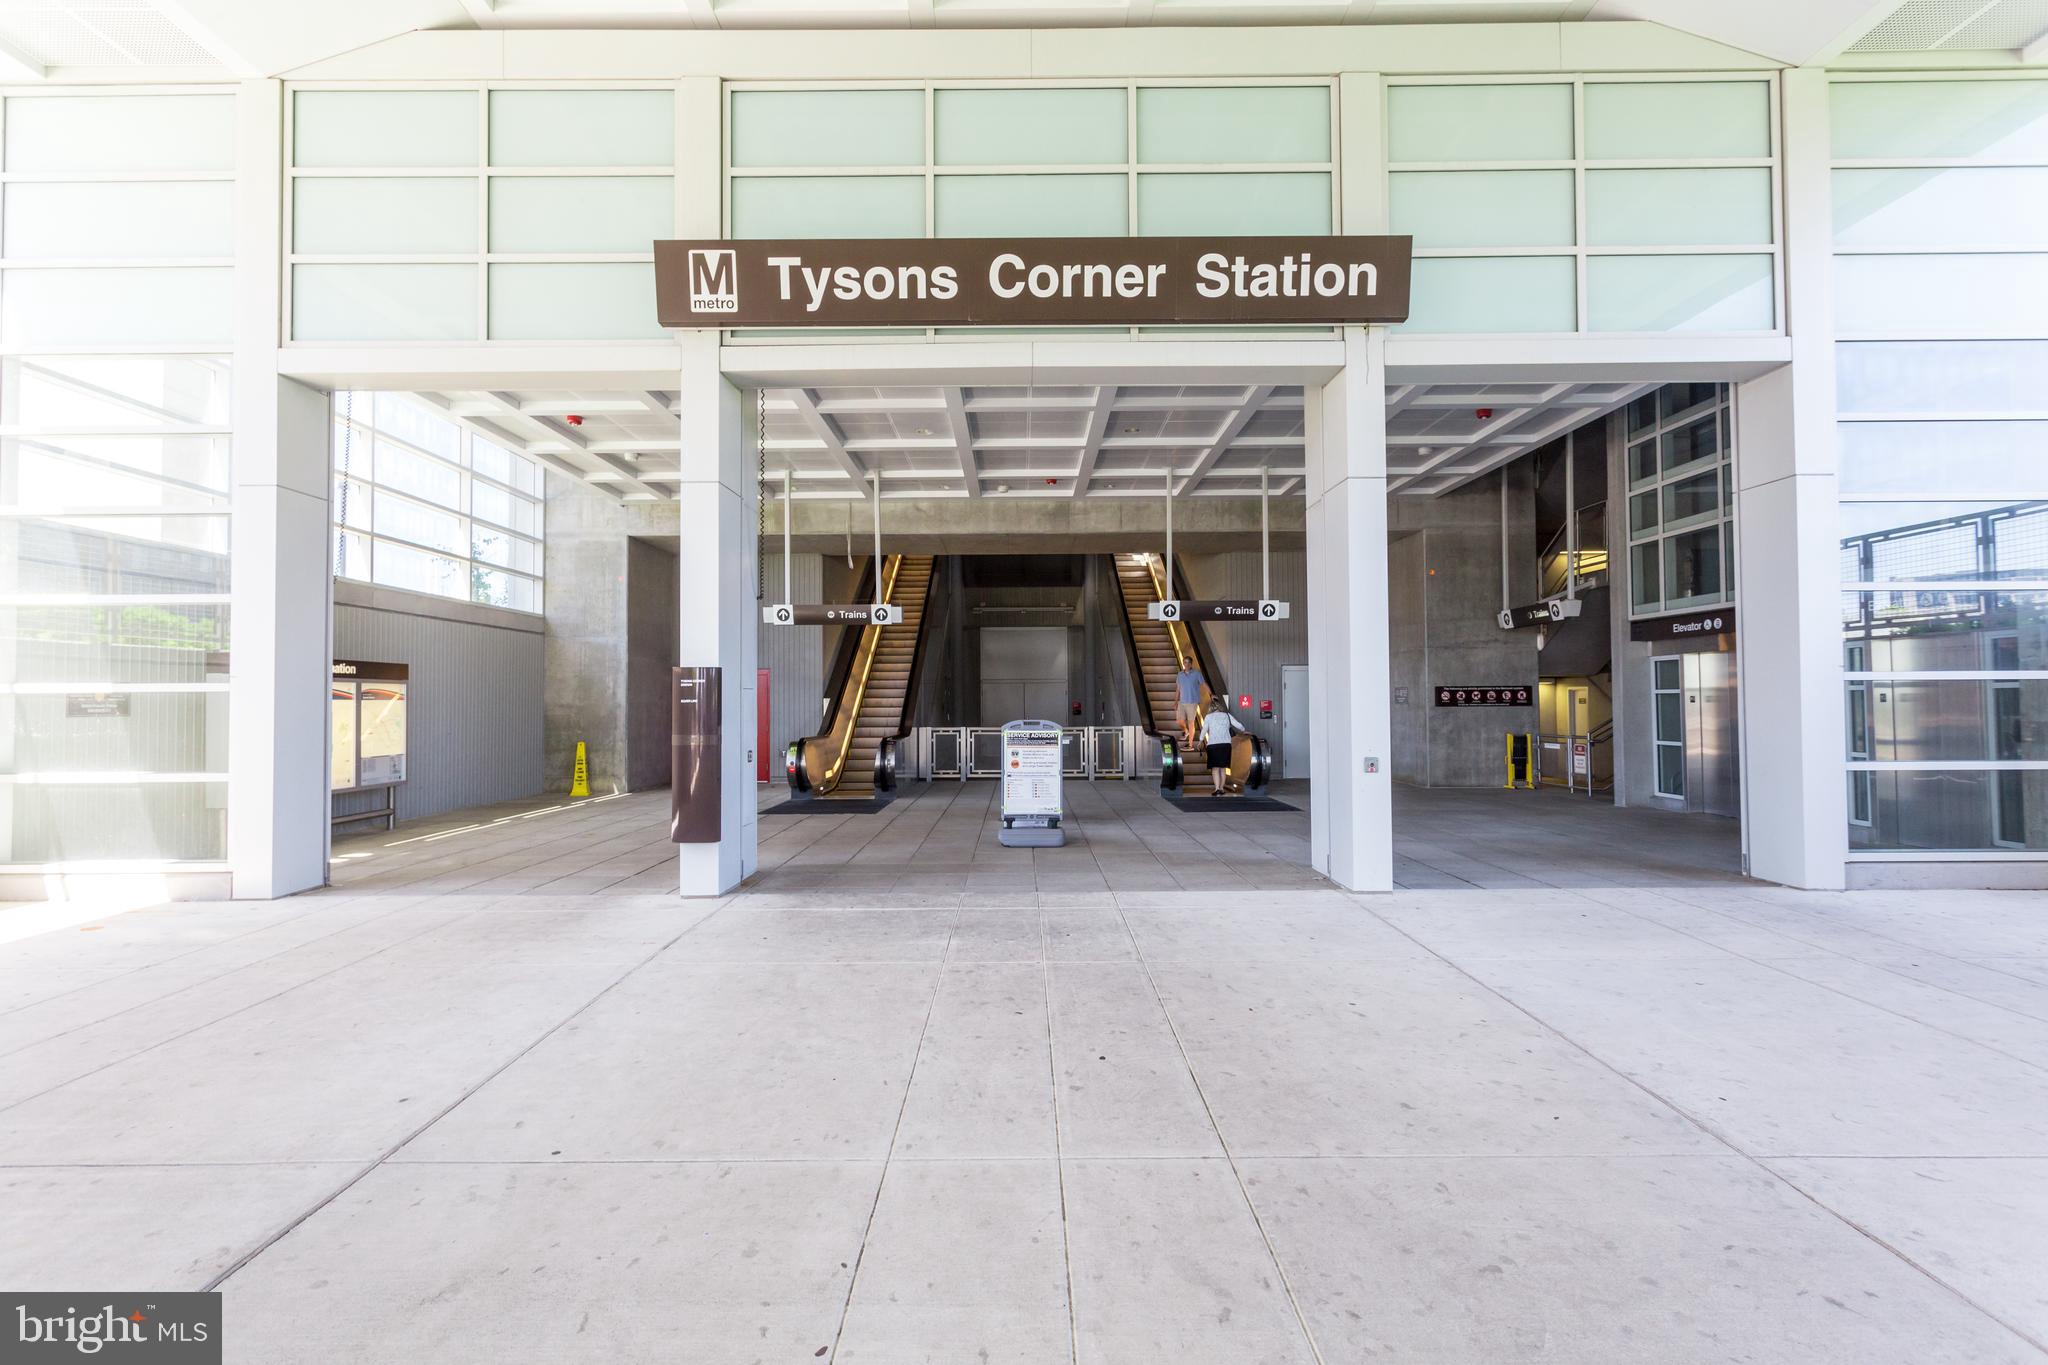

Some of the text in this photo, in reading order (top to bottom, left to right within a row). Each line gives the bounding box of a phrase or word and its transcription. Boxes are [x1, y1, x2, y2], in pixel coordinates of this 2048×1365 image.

[691, 252, 735, 295] M
[767, 252, 1378, 312] Tysons Corner Station
[693, 297, 735, 310] metro
[838, 610, 868, 619] Trains
[1226, 606, 1255, 615] Trains
[1672, 622, 1703, 633] Elevator
